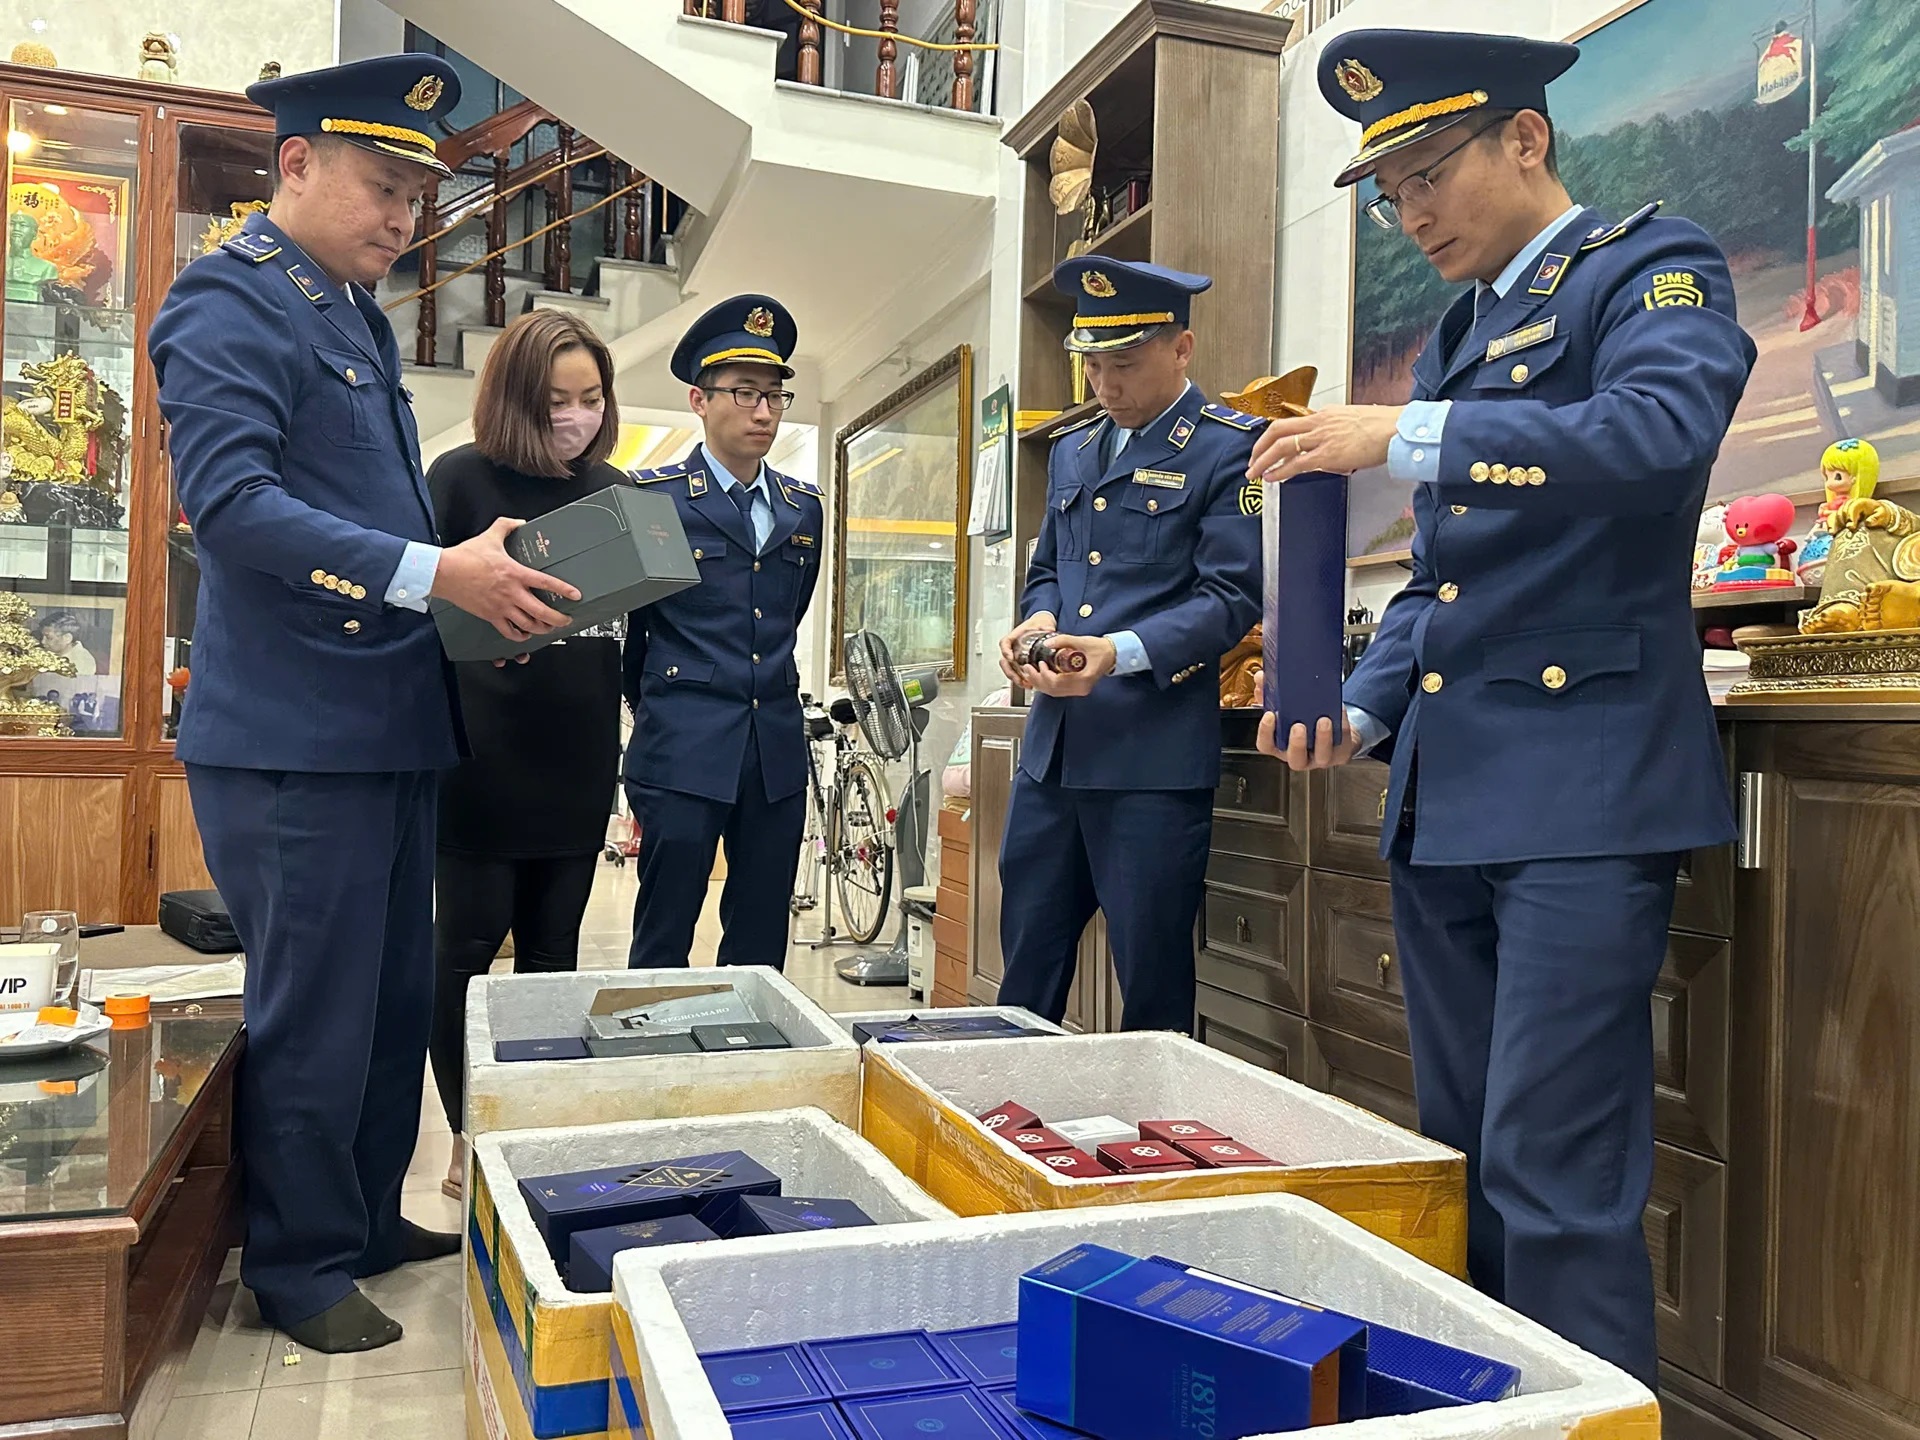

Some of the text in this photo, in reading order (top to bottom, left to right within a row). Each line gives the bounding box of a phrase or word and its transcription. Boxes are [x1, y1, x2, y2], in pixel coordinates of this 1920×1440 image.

[1652, 272, 1694, 286] DMS
[0, 978, 27, 994] VIP
[660, 1007, 729, 1024] NEGROAMARO
